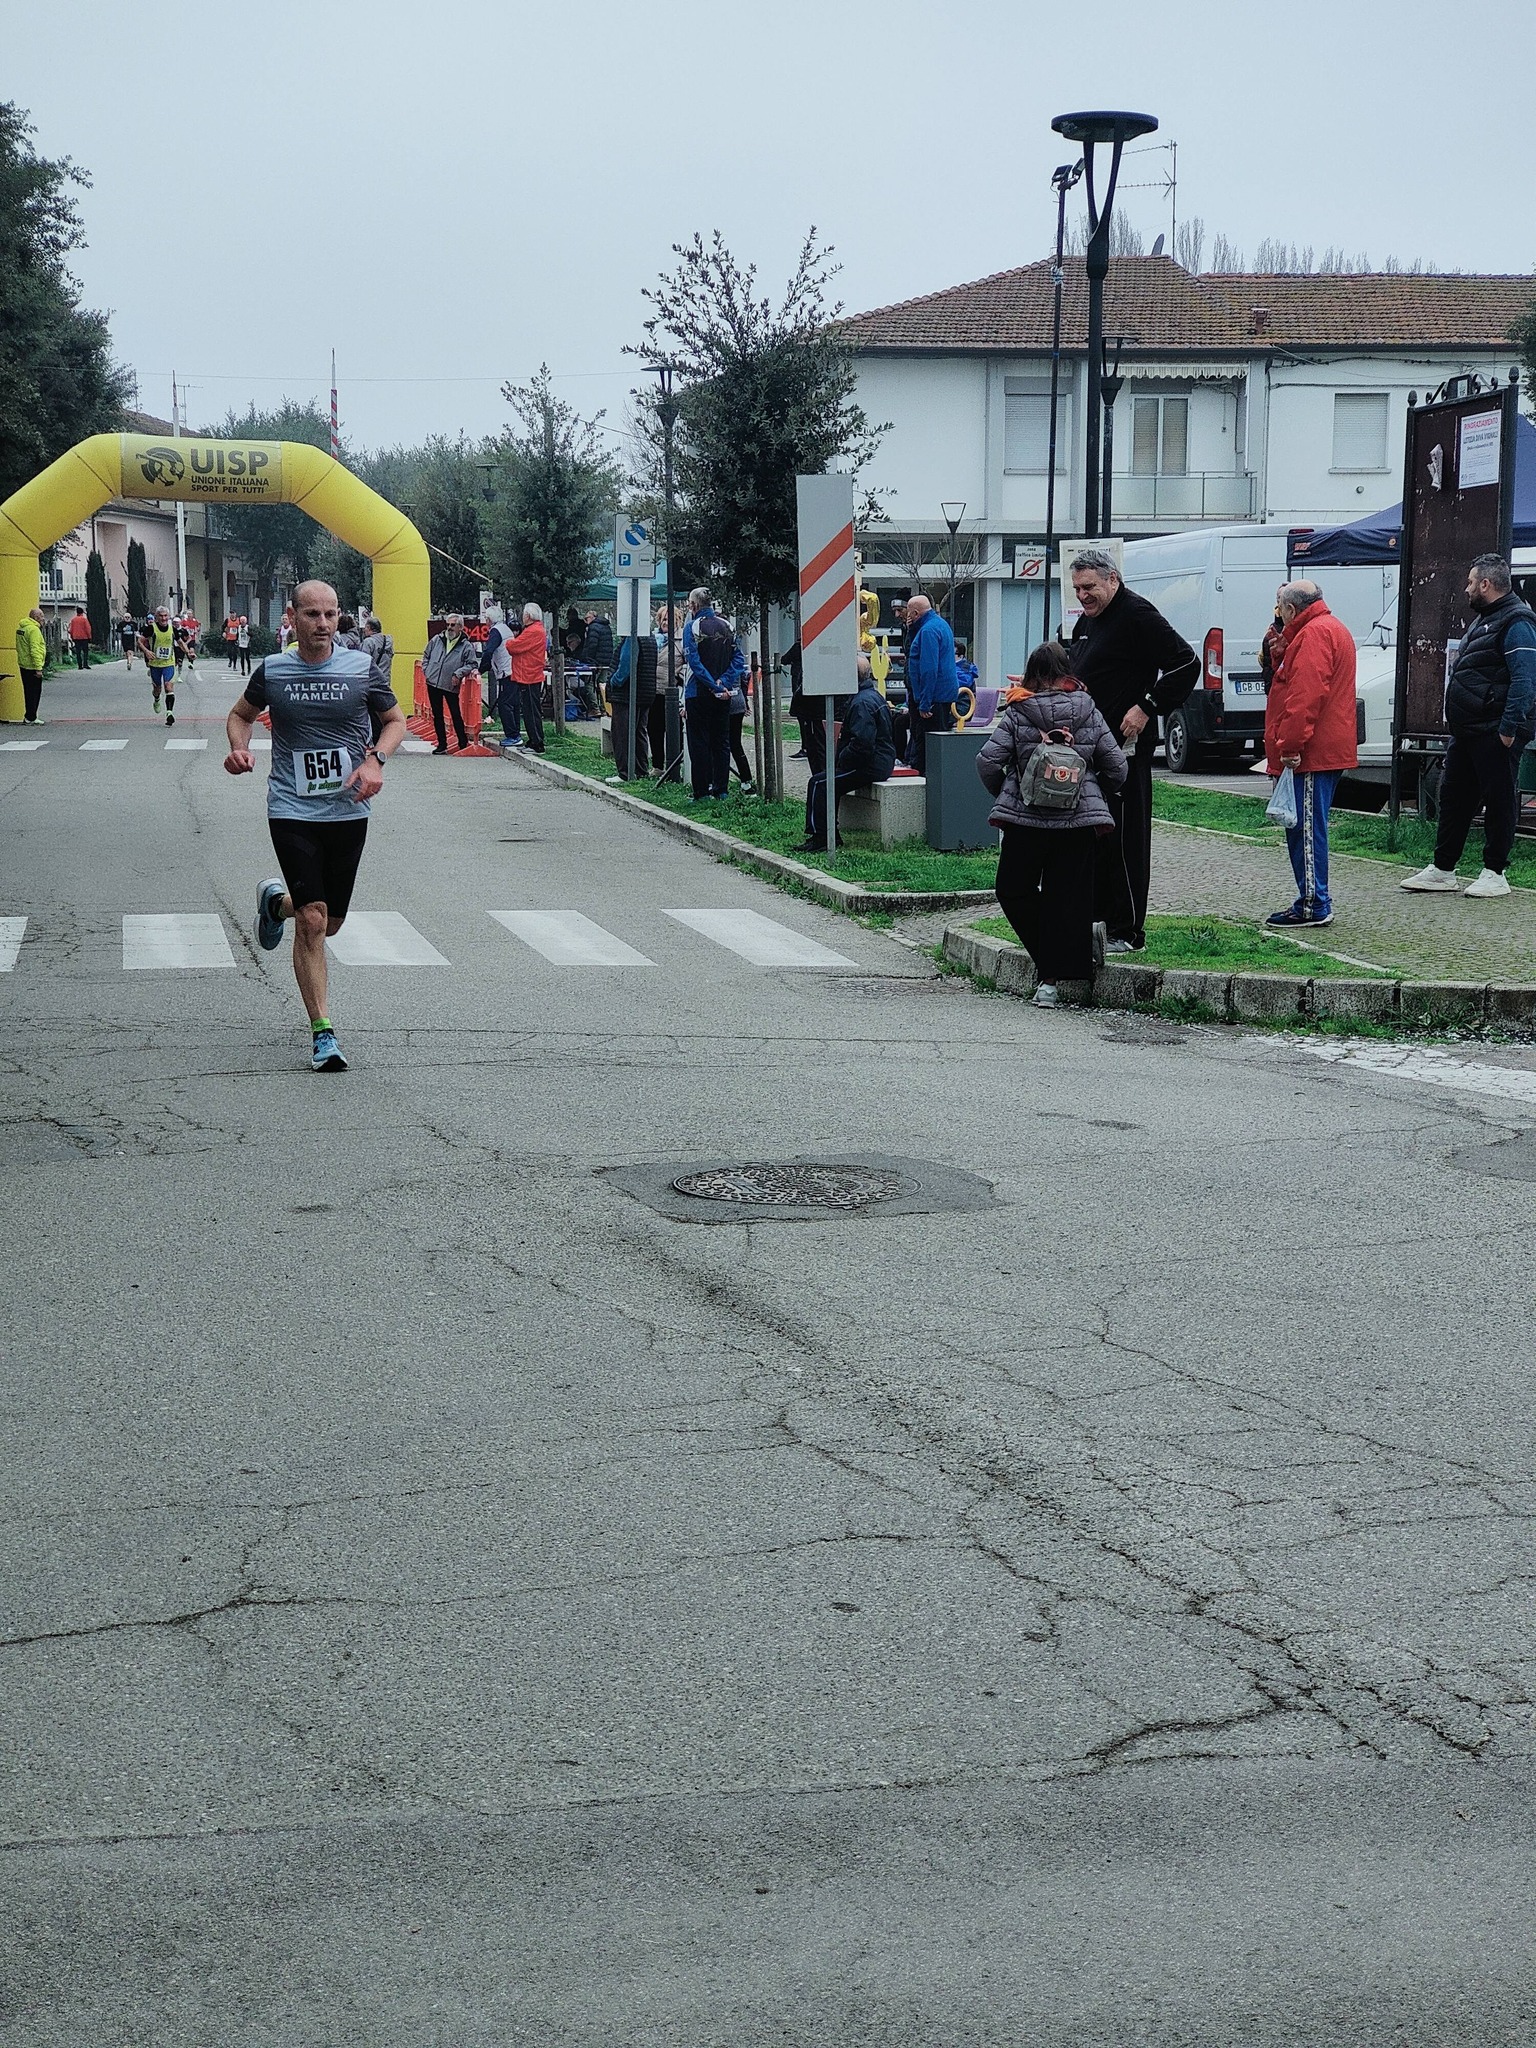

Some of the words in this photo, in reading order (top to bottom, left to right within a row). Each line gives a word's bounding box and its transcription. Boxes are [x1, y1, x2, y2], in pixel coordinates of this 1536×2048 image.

[190, 448, 269, 476] UISP
[191, 475, 226, 485] UNIONE
[229, 477, 269, 486] ITALIANA
[191, 484, 218, 493] SPORT
[222, 485, 238, 494] PER
[241, 486, 265, 494] TUTTI
[284, 682, 350, 692] ATLETICA
[290, 692, 344, 701] MAMELI
[303, 750, 343, 780] 654
